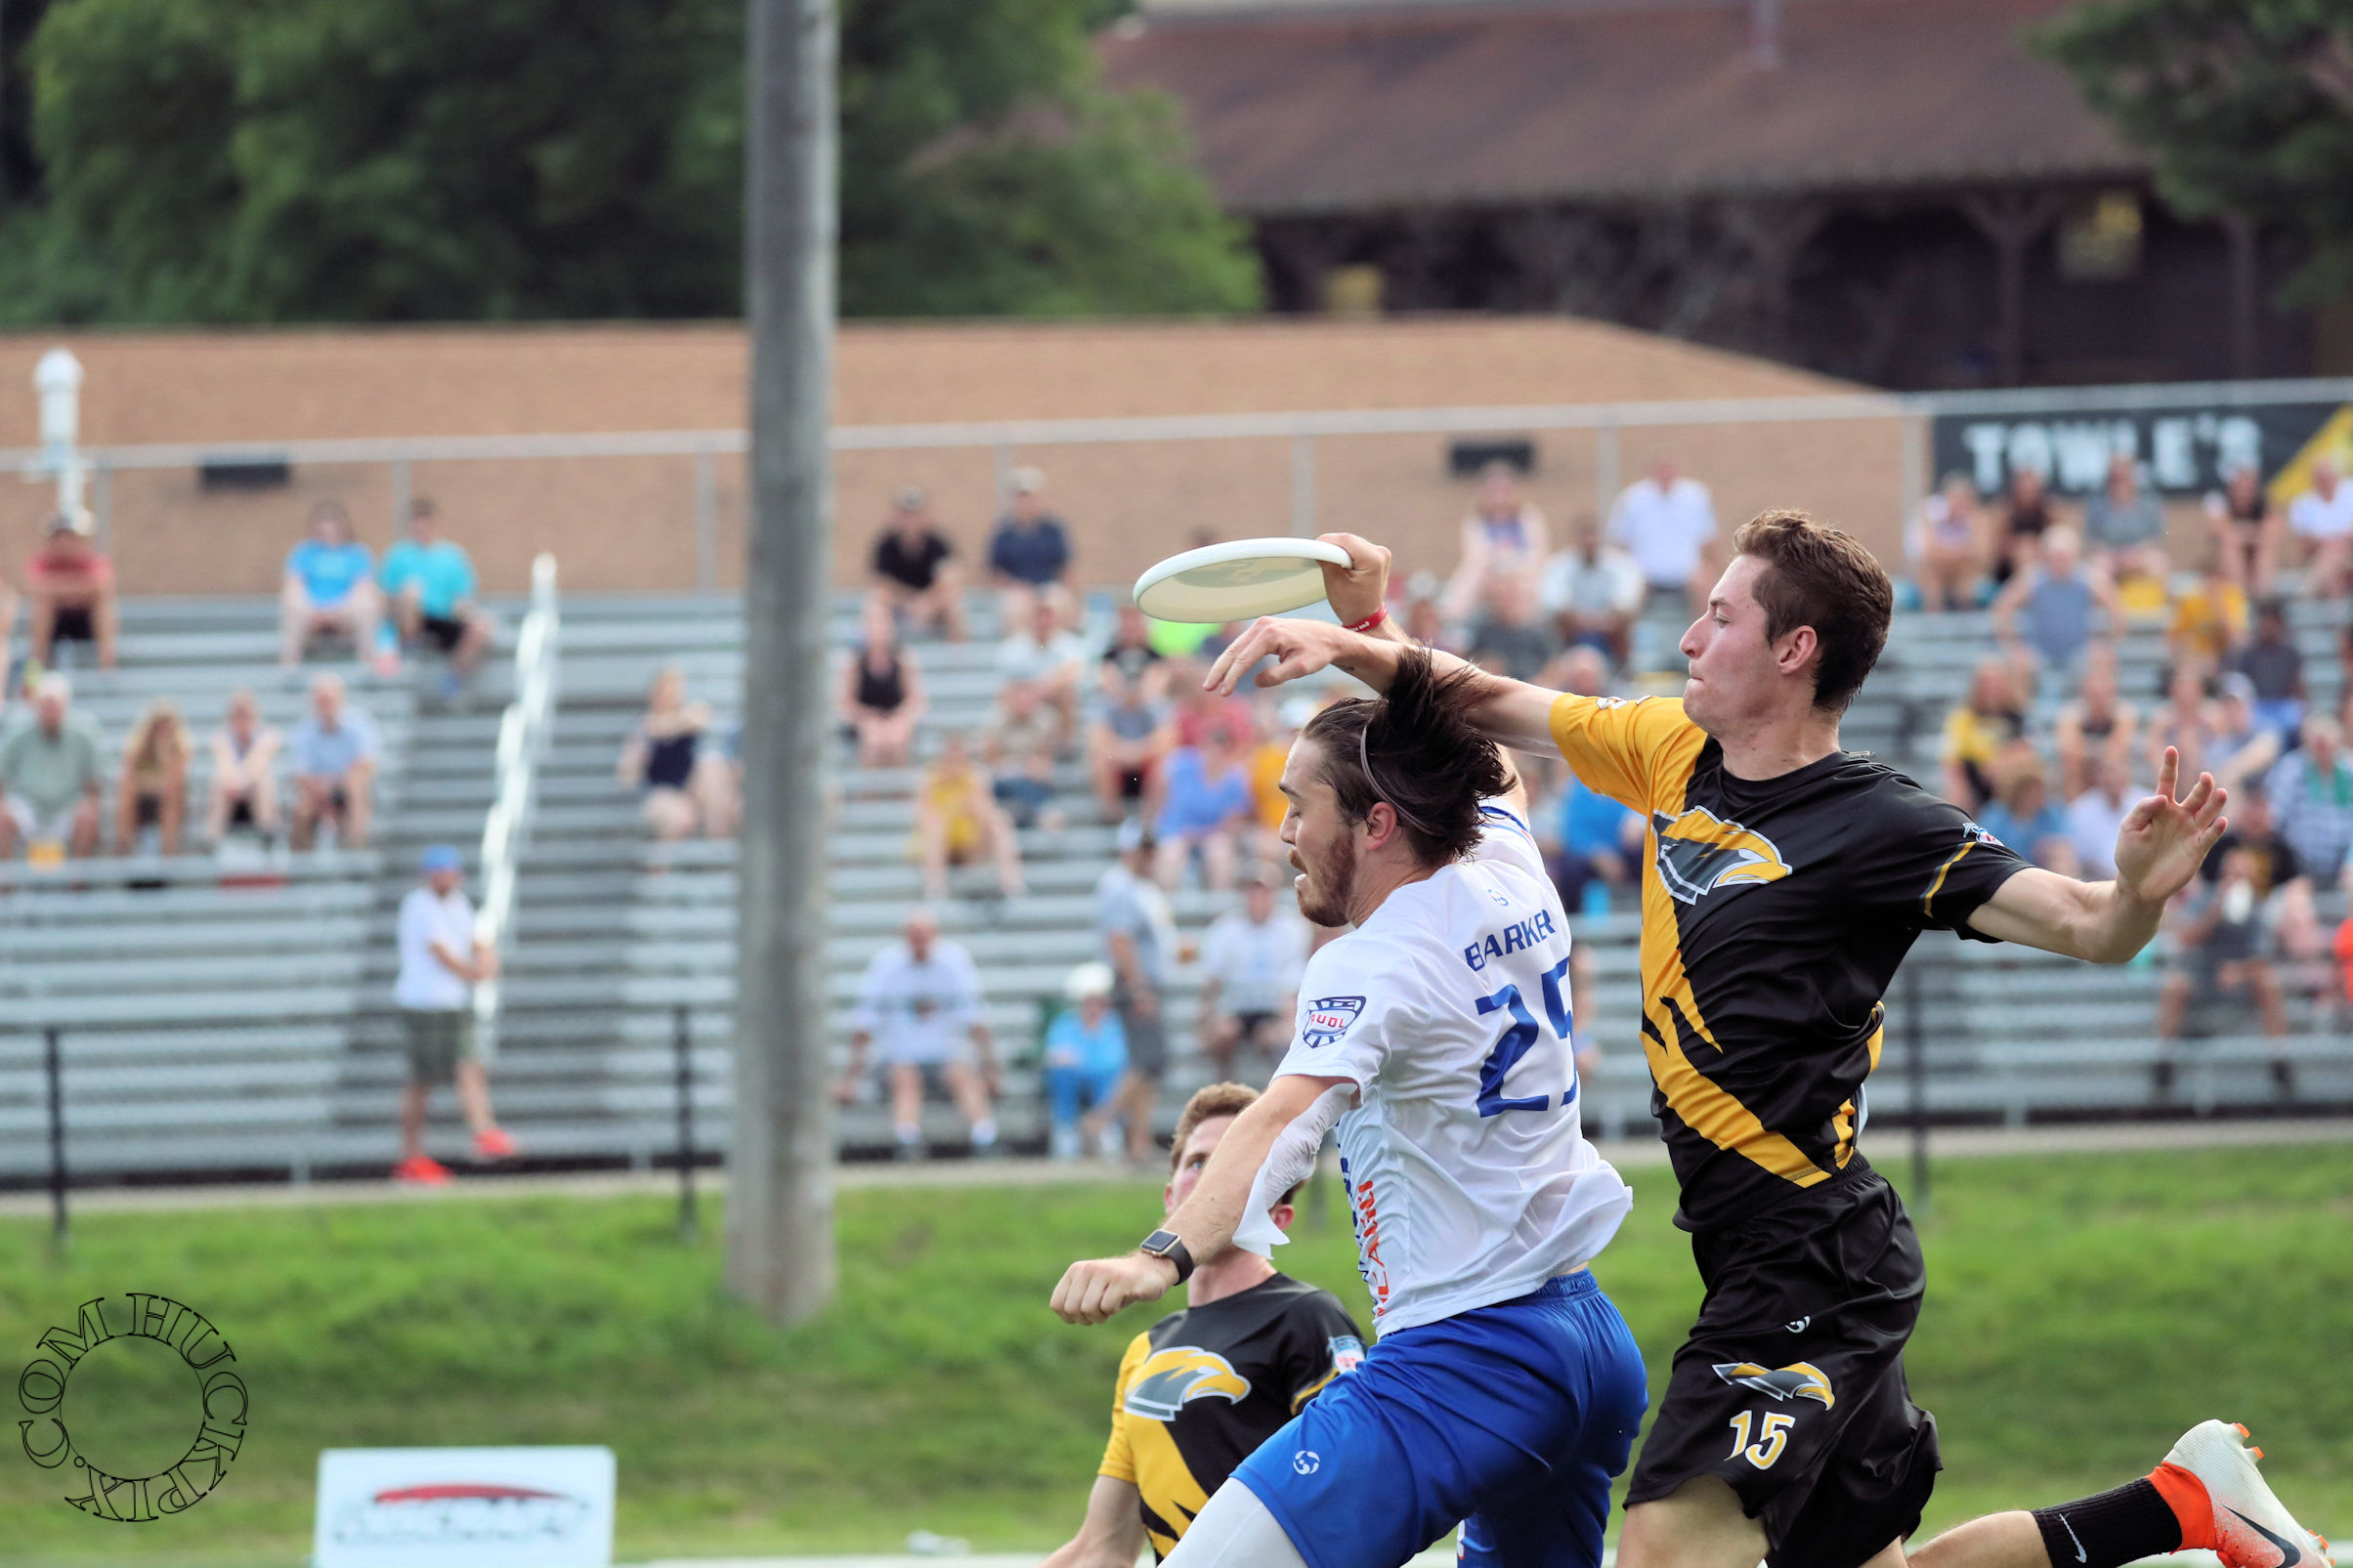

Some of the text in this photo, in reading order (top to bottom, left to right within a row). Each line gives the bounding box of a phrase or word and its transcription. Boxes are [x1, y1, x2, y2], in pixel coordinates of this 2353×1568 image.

[1465, 909, 1556, 972] BARKER
[1310, 1013, 1345, 1029] AUDL
[1475, 956, 1578, 1119] 25
[1724, 1410, 1796, 1469] 15
